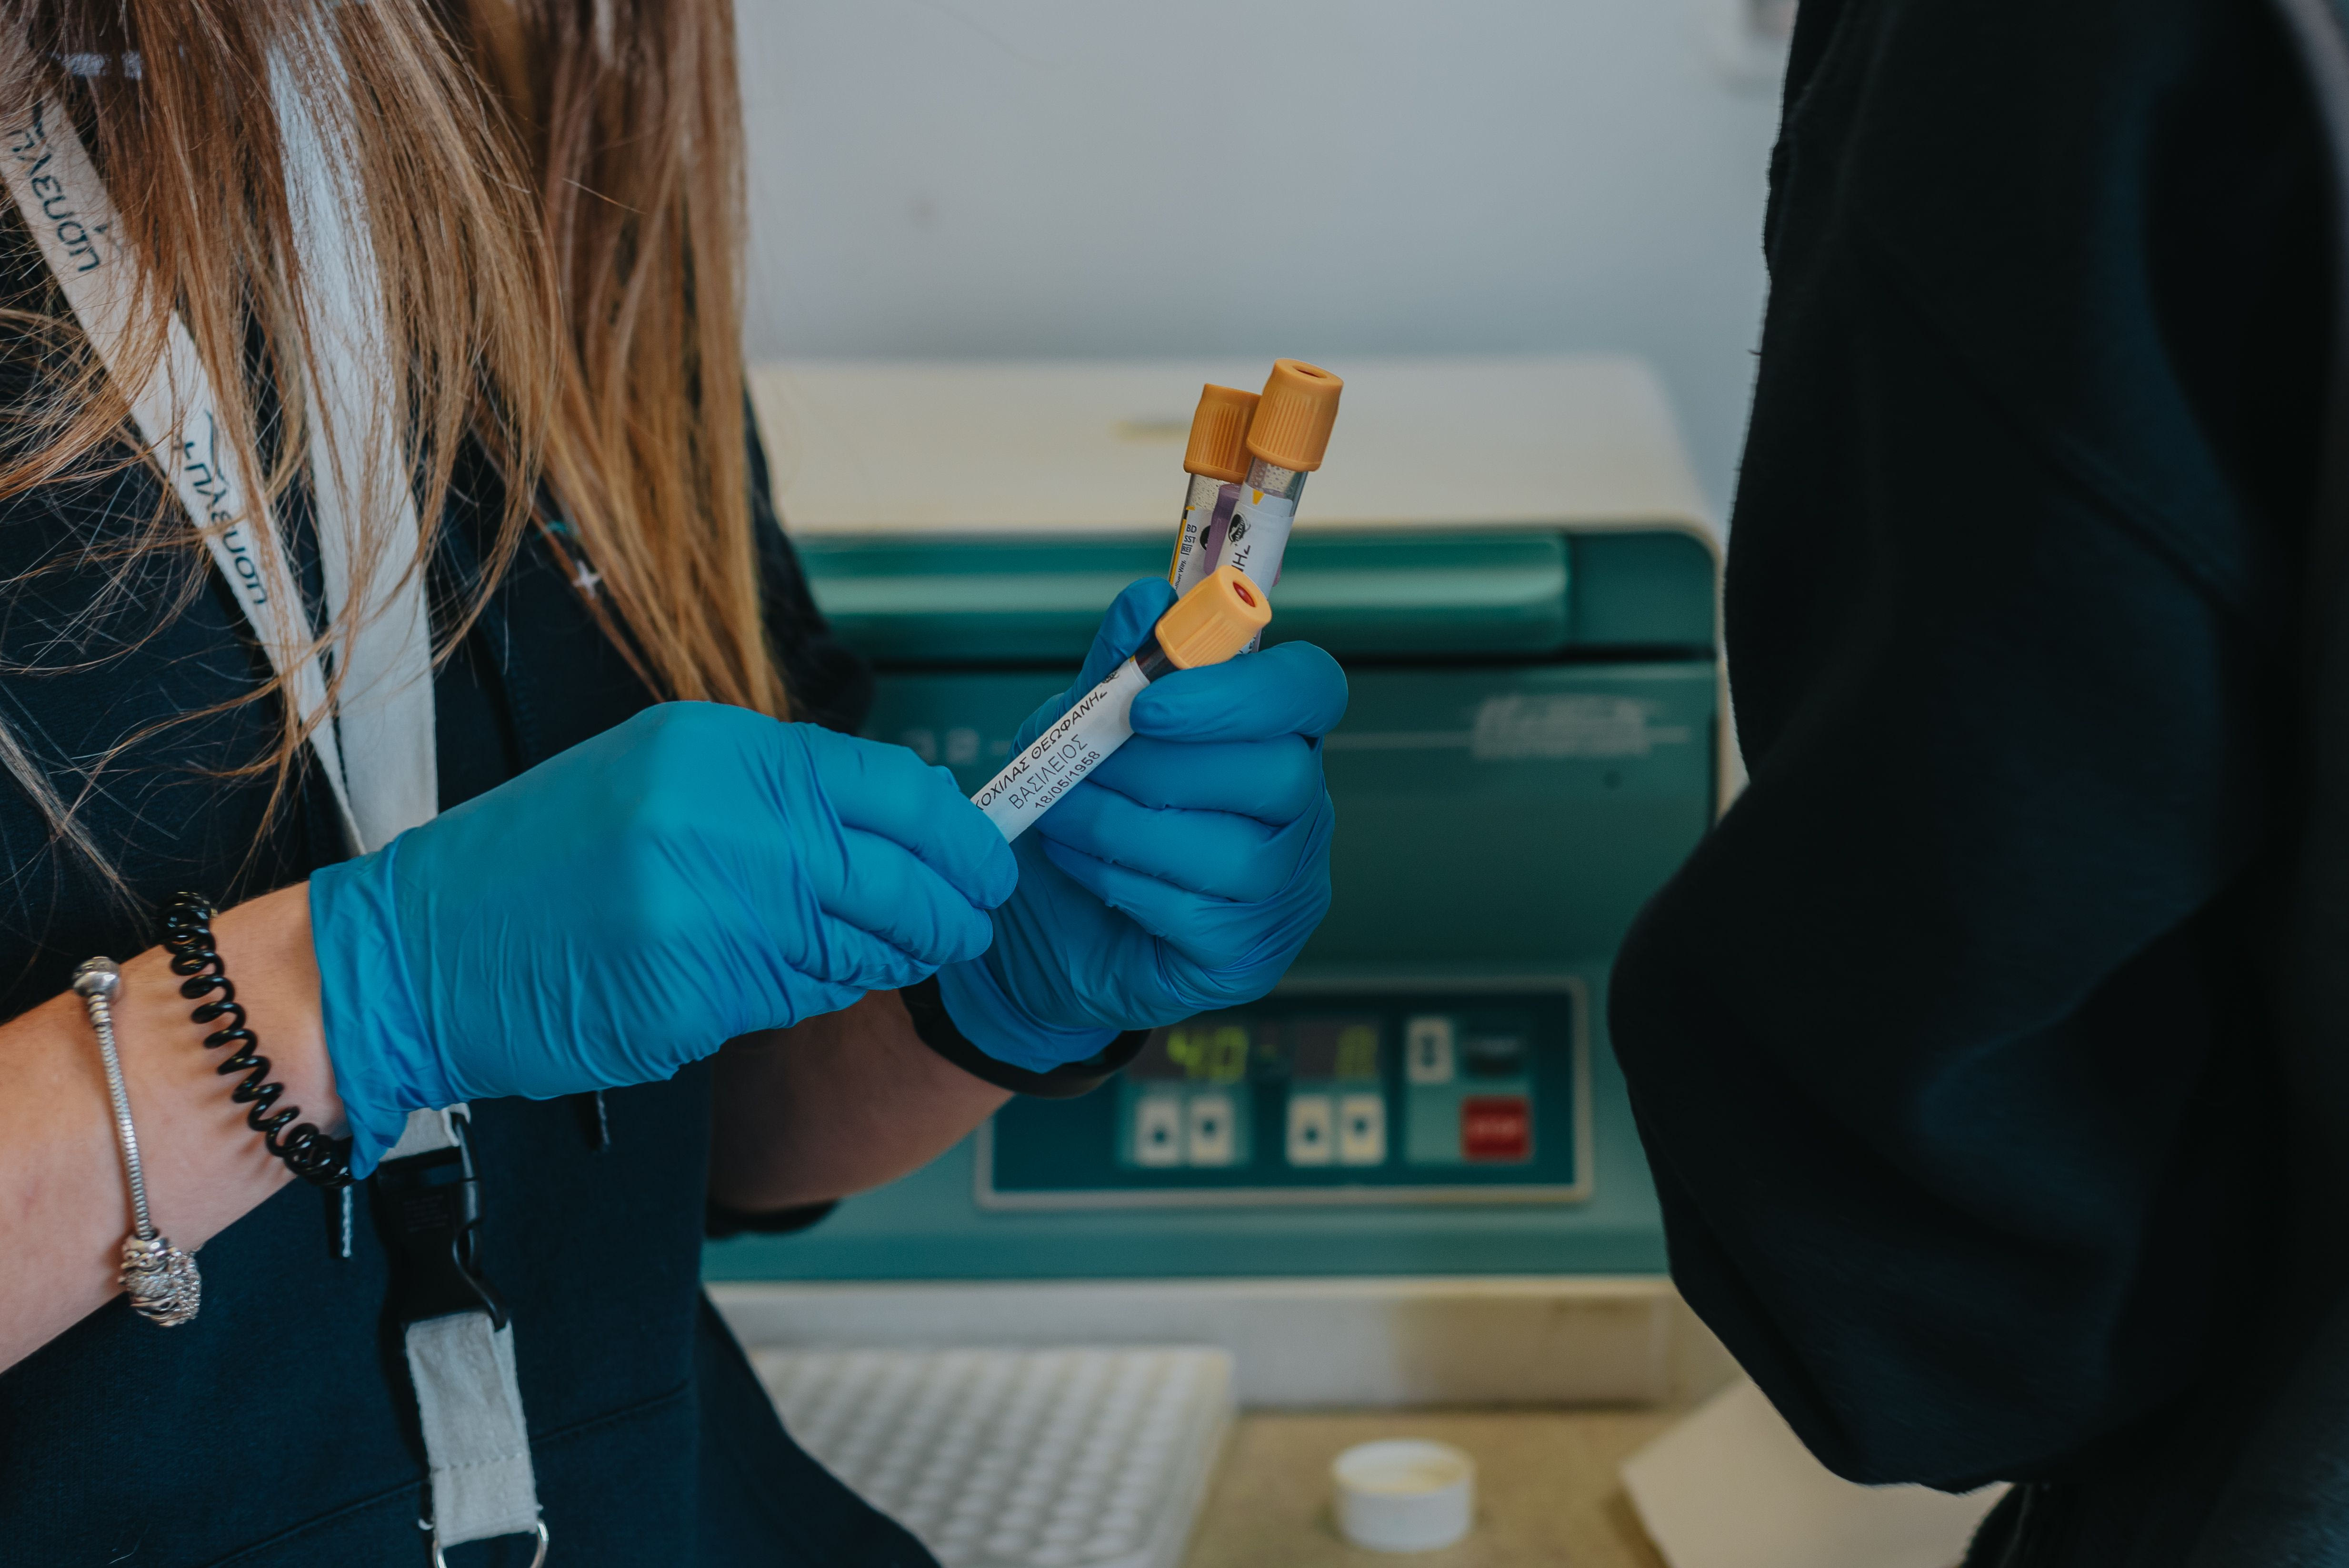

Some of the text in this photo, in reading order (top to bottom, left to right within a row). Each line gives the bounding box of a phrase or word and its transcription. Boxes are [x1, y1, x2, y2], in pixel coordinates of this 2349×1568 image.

[1184, 535, 1196, 544] SST
[1186, 524, 1197, 533] BD
[1008, 734, 1088, 809] ΒΑΣΙΛΕΙΟΣ
[1035, 750, 1100, 808] 18/05/1958
